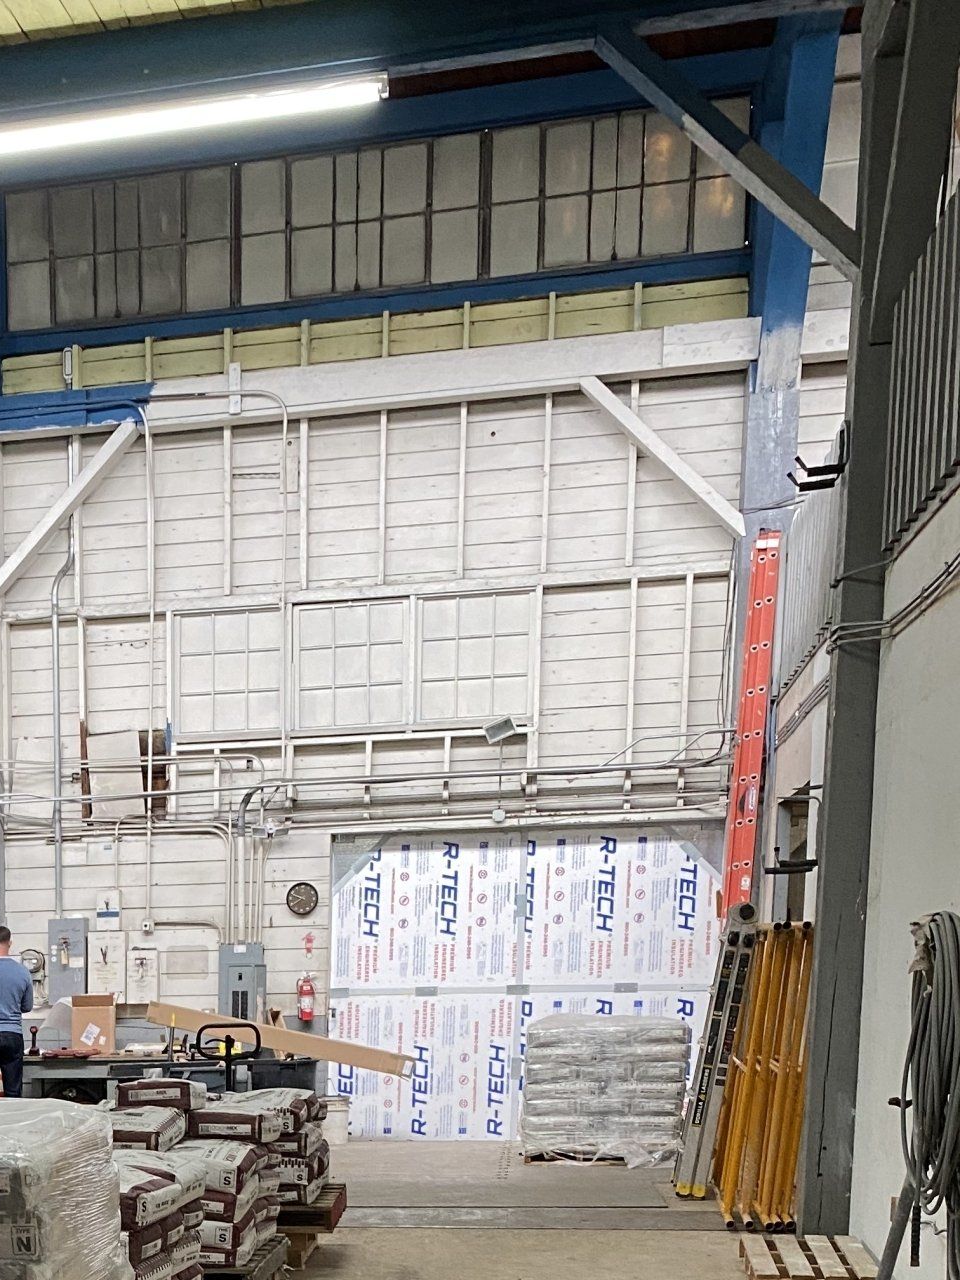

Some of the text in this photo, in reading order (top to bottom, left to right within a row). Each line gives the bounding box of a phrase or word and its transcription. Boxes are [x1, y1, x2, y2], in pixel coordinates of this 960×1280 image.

[440, 841, 460, 937] R-TECH
[596, 835, 617, 932] R-TECH
[678, 855, 698, 931] -TECH
[411, 1045, 429, 1136] R-TECH
[487, 1044, 505, 1136] R-TECH
[694, 1101, 704, 1124] GORILLA
[283, 1122, 289, 1130] S
[224, 1176, 231, 1186] S
[296, 1174, 303, 1182] S
[141, 1201, 147, 1213] S
[16, 1237, 32, 1254] N
[219, 1233, 227, 1243] S
